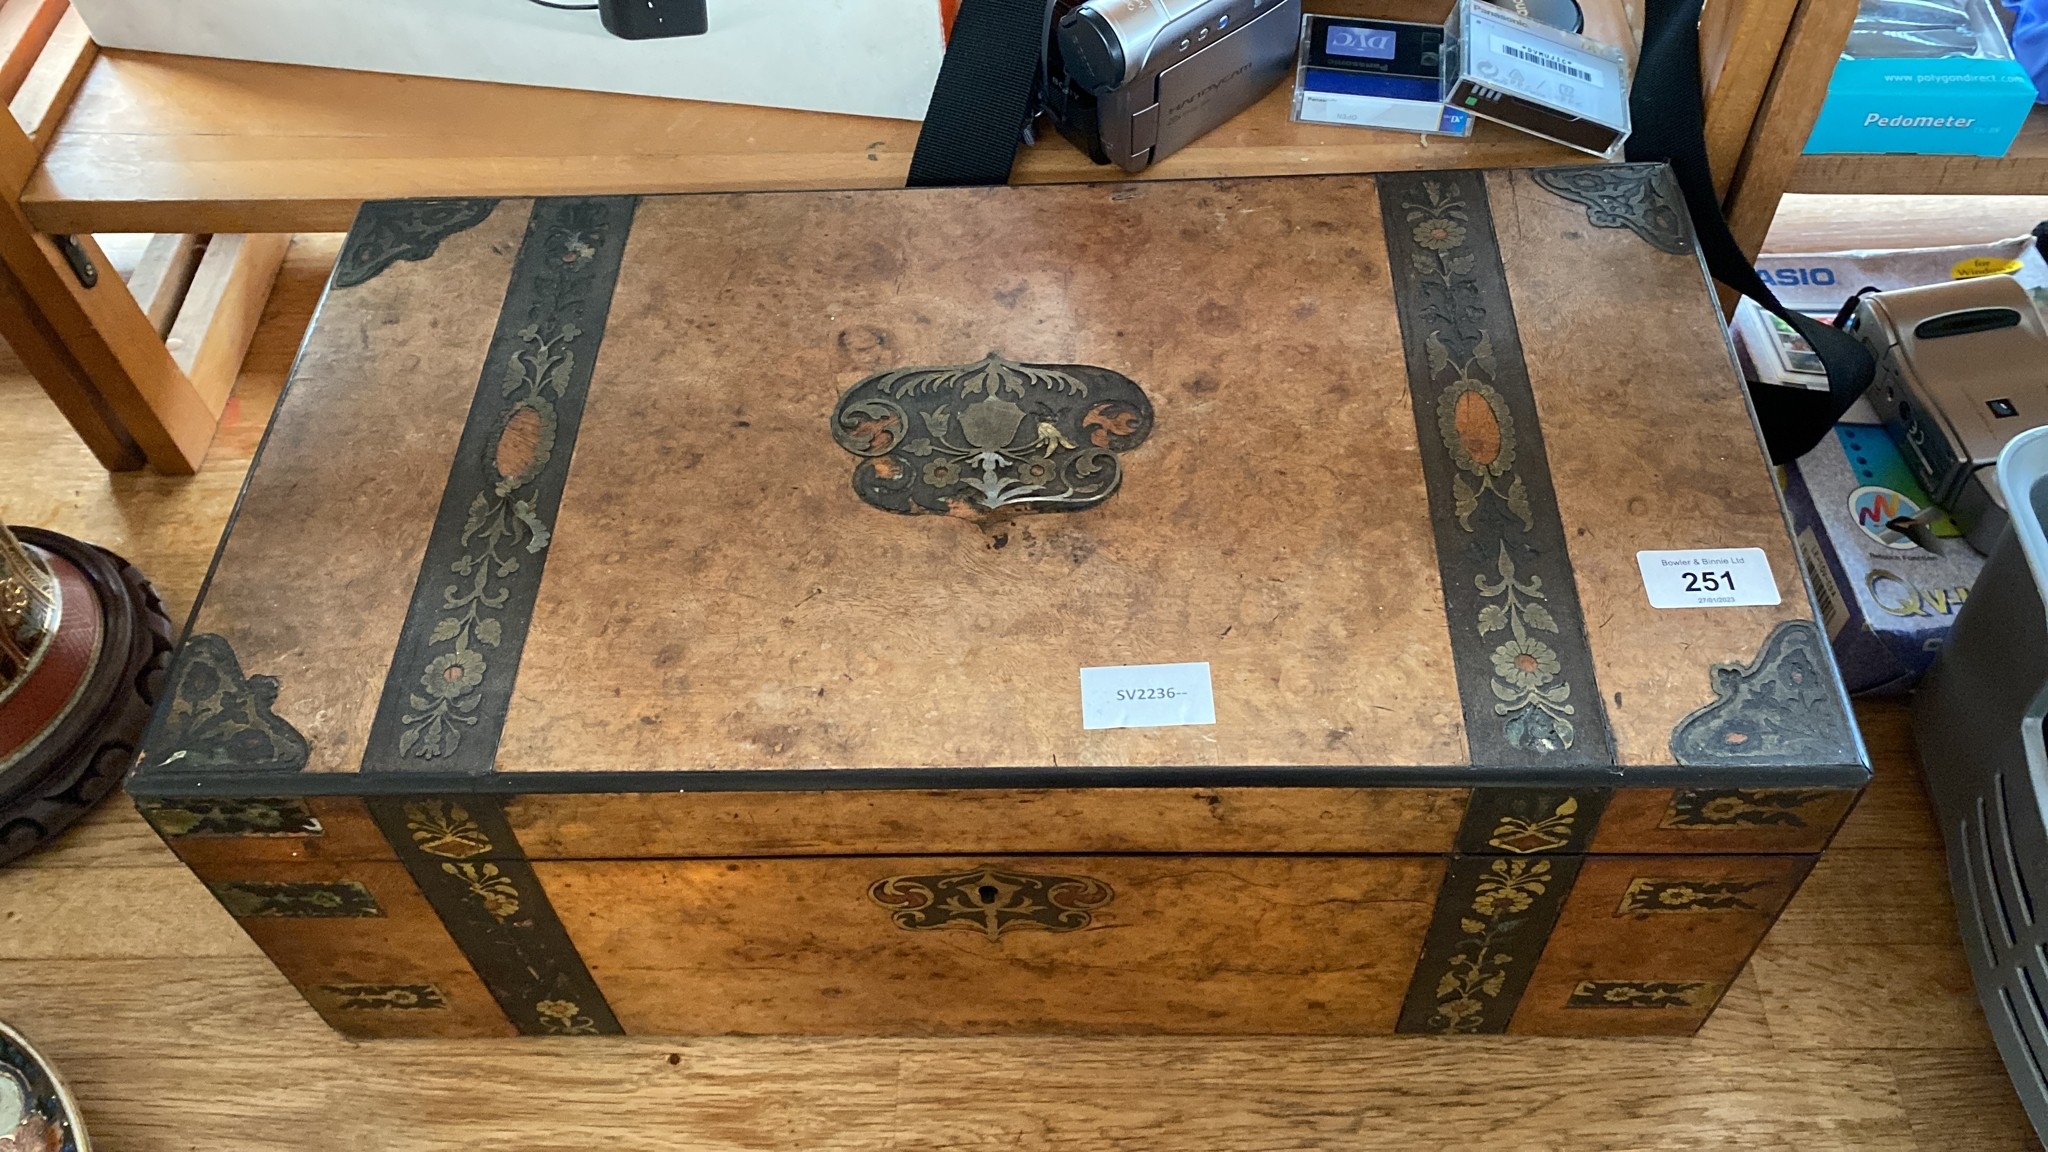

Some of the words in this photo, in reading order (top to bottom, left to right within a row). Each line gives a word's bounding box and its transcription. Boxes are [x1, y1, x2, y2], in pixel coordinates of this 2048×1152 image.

[1473, 5, 1528, 27] Panasonic
[1332, 32, 1392, 51] DVC
[1863, 112, 1976, 129] Pedometer
[1974, 259, 1990, 267] for
[1760, 267, 1835, 286] ASIO
[1660, 559, 1691, 567] Bowler
[1681, 570, 1735, 592] 251
[1698, 596, 1735, 604] 27/01/2023
[1116, 687, 1188, 701] SV2236--
